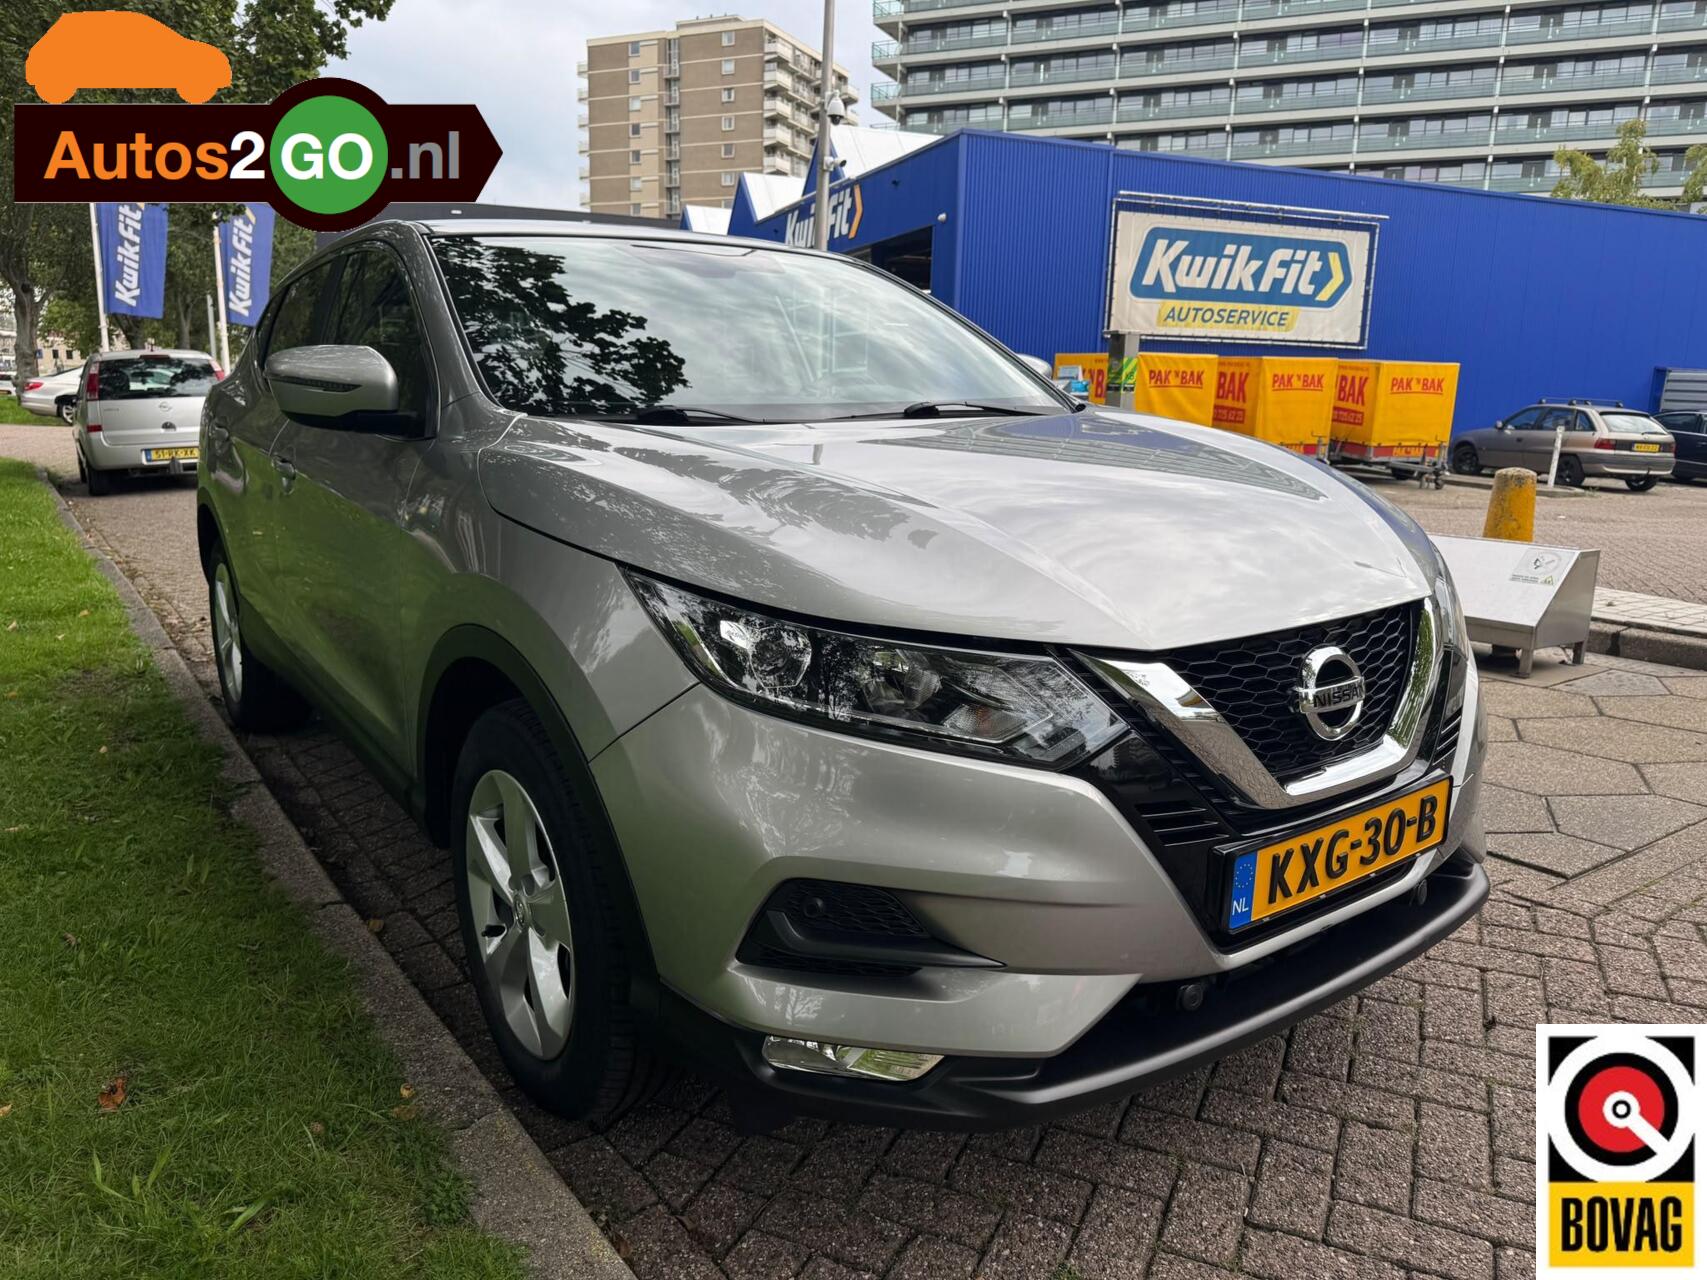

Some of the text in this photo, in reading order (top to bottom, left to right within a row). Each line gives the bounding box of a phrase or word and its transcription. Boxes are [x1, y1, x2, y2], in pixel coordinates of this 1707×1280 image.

[1164, 306, 1290, 327] AUTOSERVICE
[1149, 369, 1172, 385] PAK
[1180, 369, 1205, 385] BAK
[1272, 373, 1294, 388] PAK
[1301, 374, 1324, 388] BAK
[1391, 377, 1413, 391] PAK
[1421, 377, 1445, 392] BAK
[1216, 371, 1249, 403] BAK
[1338, 375, 1368, 406] BAK
[1267, 795, 1438, 904] KXG-30-B
[1231, 897, 1249, 915] NL
